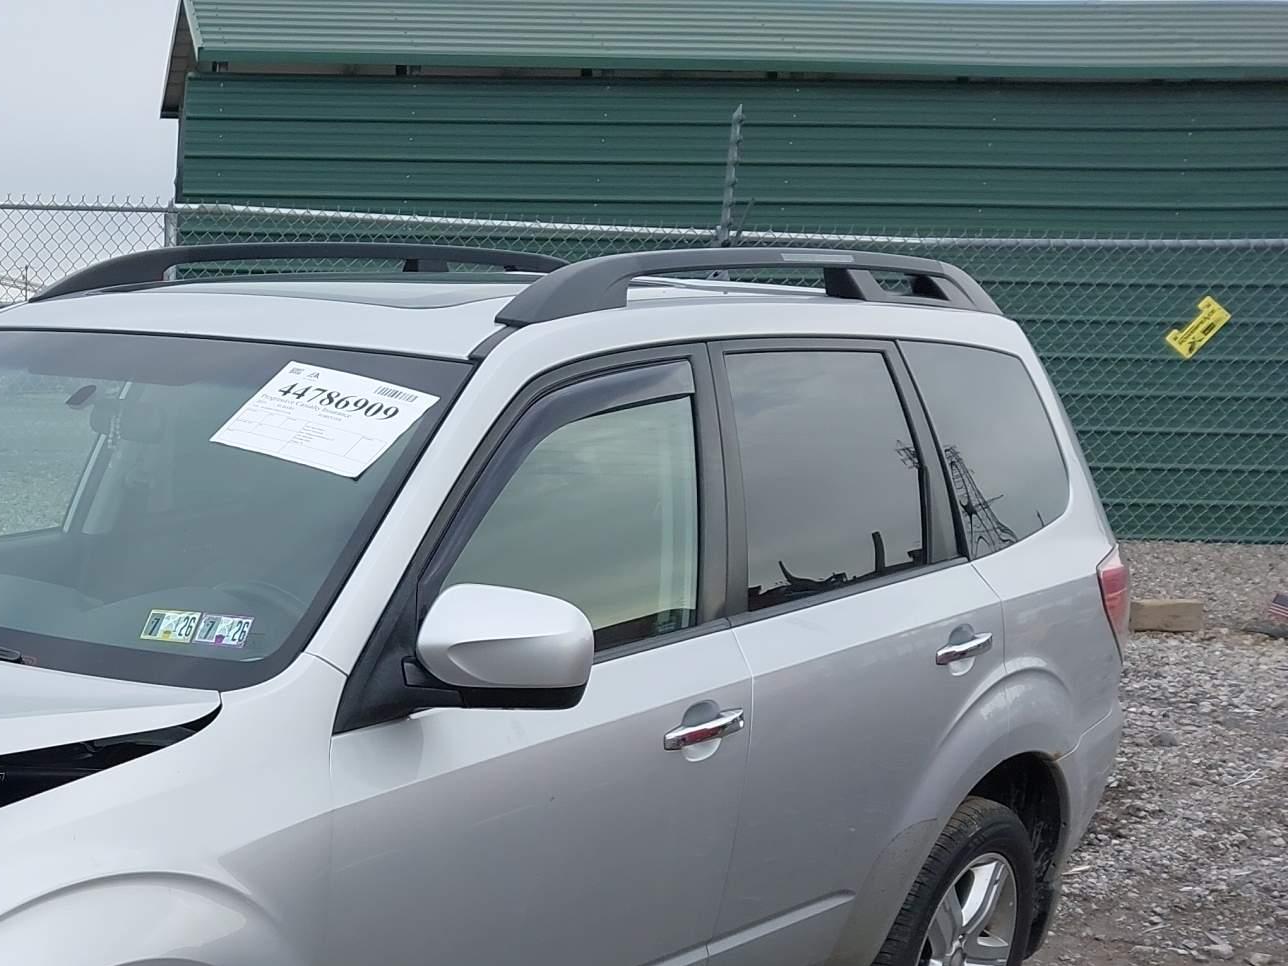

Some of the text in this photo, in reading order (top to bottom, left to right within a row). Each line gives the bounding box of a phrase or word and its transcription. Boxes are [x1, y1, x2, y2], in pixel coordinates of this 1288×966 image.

[278, 382, 399, 421] 44786909
[149, 616, 196, 637] 7 26
[204, 620, 249, 642] 7 26
